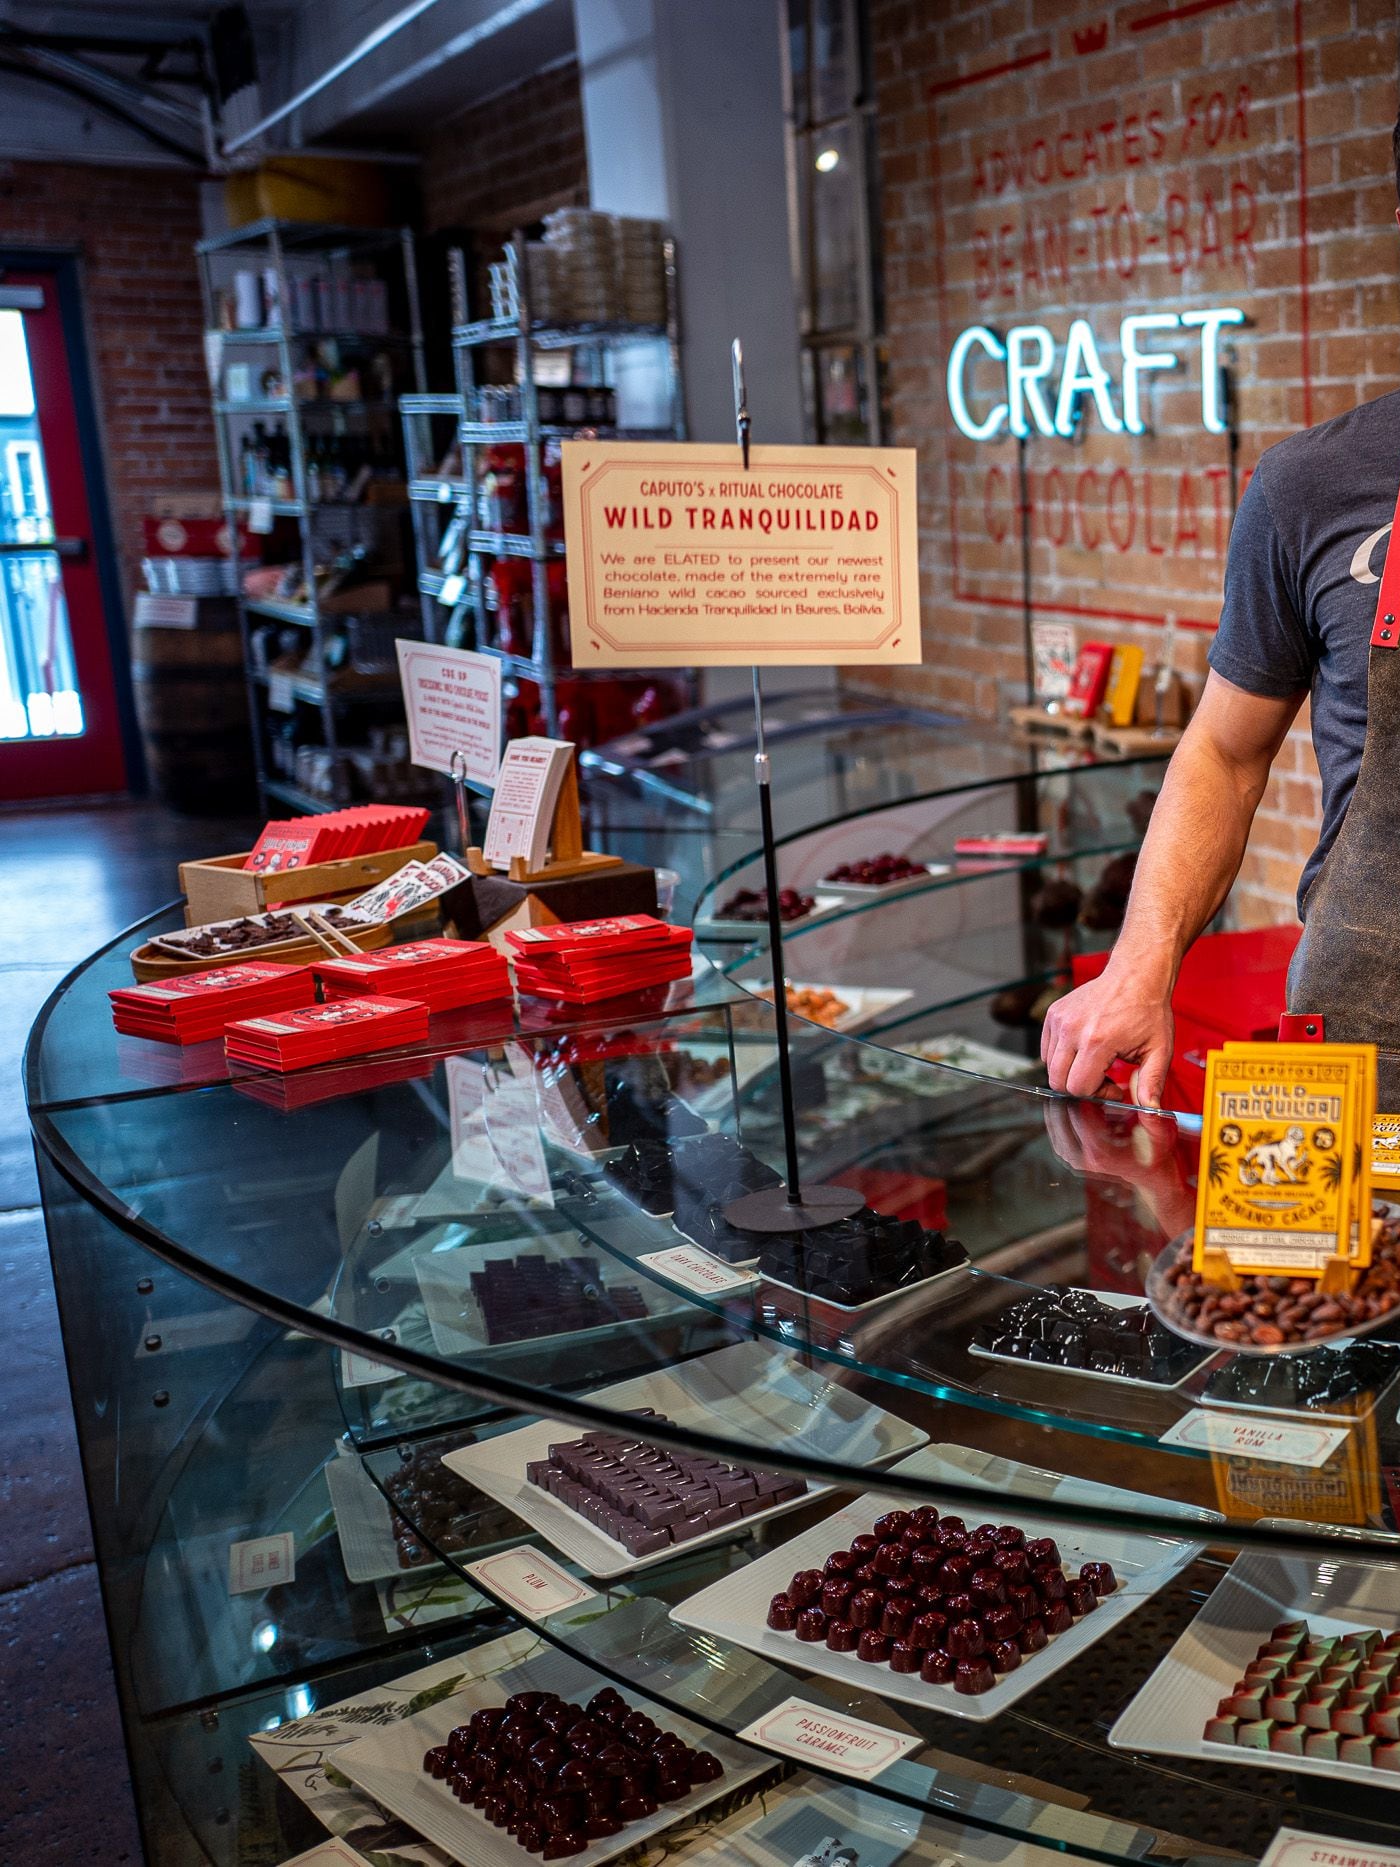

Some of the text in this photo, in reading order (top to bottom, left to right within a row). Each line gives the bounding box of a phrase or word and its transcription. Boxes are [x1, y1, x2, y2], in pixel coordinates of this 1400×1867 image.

[972, 84, 1252, 198] ADVOCATES FOR
[972, 181, 1258, 300] BEAN-TO-BAR
[946, 307, 1245, 442] CRAFT
[640, 481, 705, 497] CAPUTO'S
[720, 482, 764, 498] RITUAL
[768, 483, 843, 499] CHOCOLATE
[604, 506, 879, 535] WILD TRANQUILIDAD
[600, 553, 883, 568] We are ELATED to present our newest
[685, 571, 725, 581] made
[731, 571, 745, 581] of
[750, 571, 773, 582] the
[778, 571, 848, 585] extremely
[853, 573, 880, 582] rare
[603, 587, 884, 601] Beniano wild cacao sourced exclusively
[604, 604, 635, 616] from
[638, 604, 698, 616] Hacienda
[703, 604, 777, 617] Tranquilidad
[781, 604, 792, 615] in
[1251, 1084, 1307, 1098] WILD
[1281, 1199, 1327, 1226] CACAO
[1232, 1426, 1285, 1441] VANILLA
[1235, 1438, 1265, 1448] RUM
[522, 1573, 548, 1590] PLUM
[796, 1718, 879, 1751] PASSIONFRUIT
[796, 1733, 849, 1757] CARAMEL
